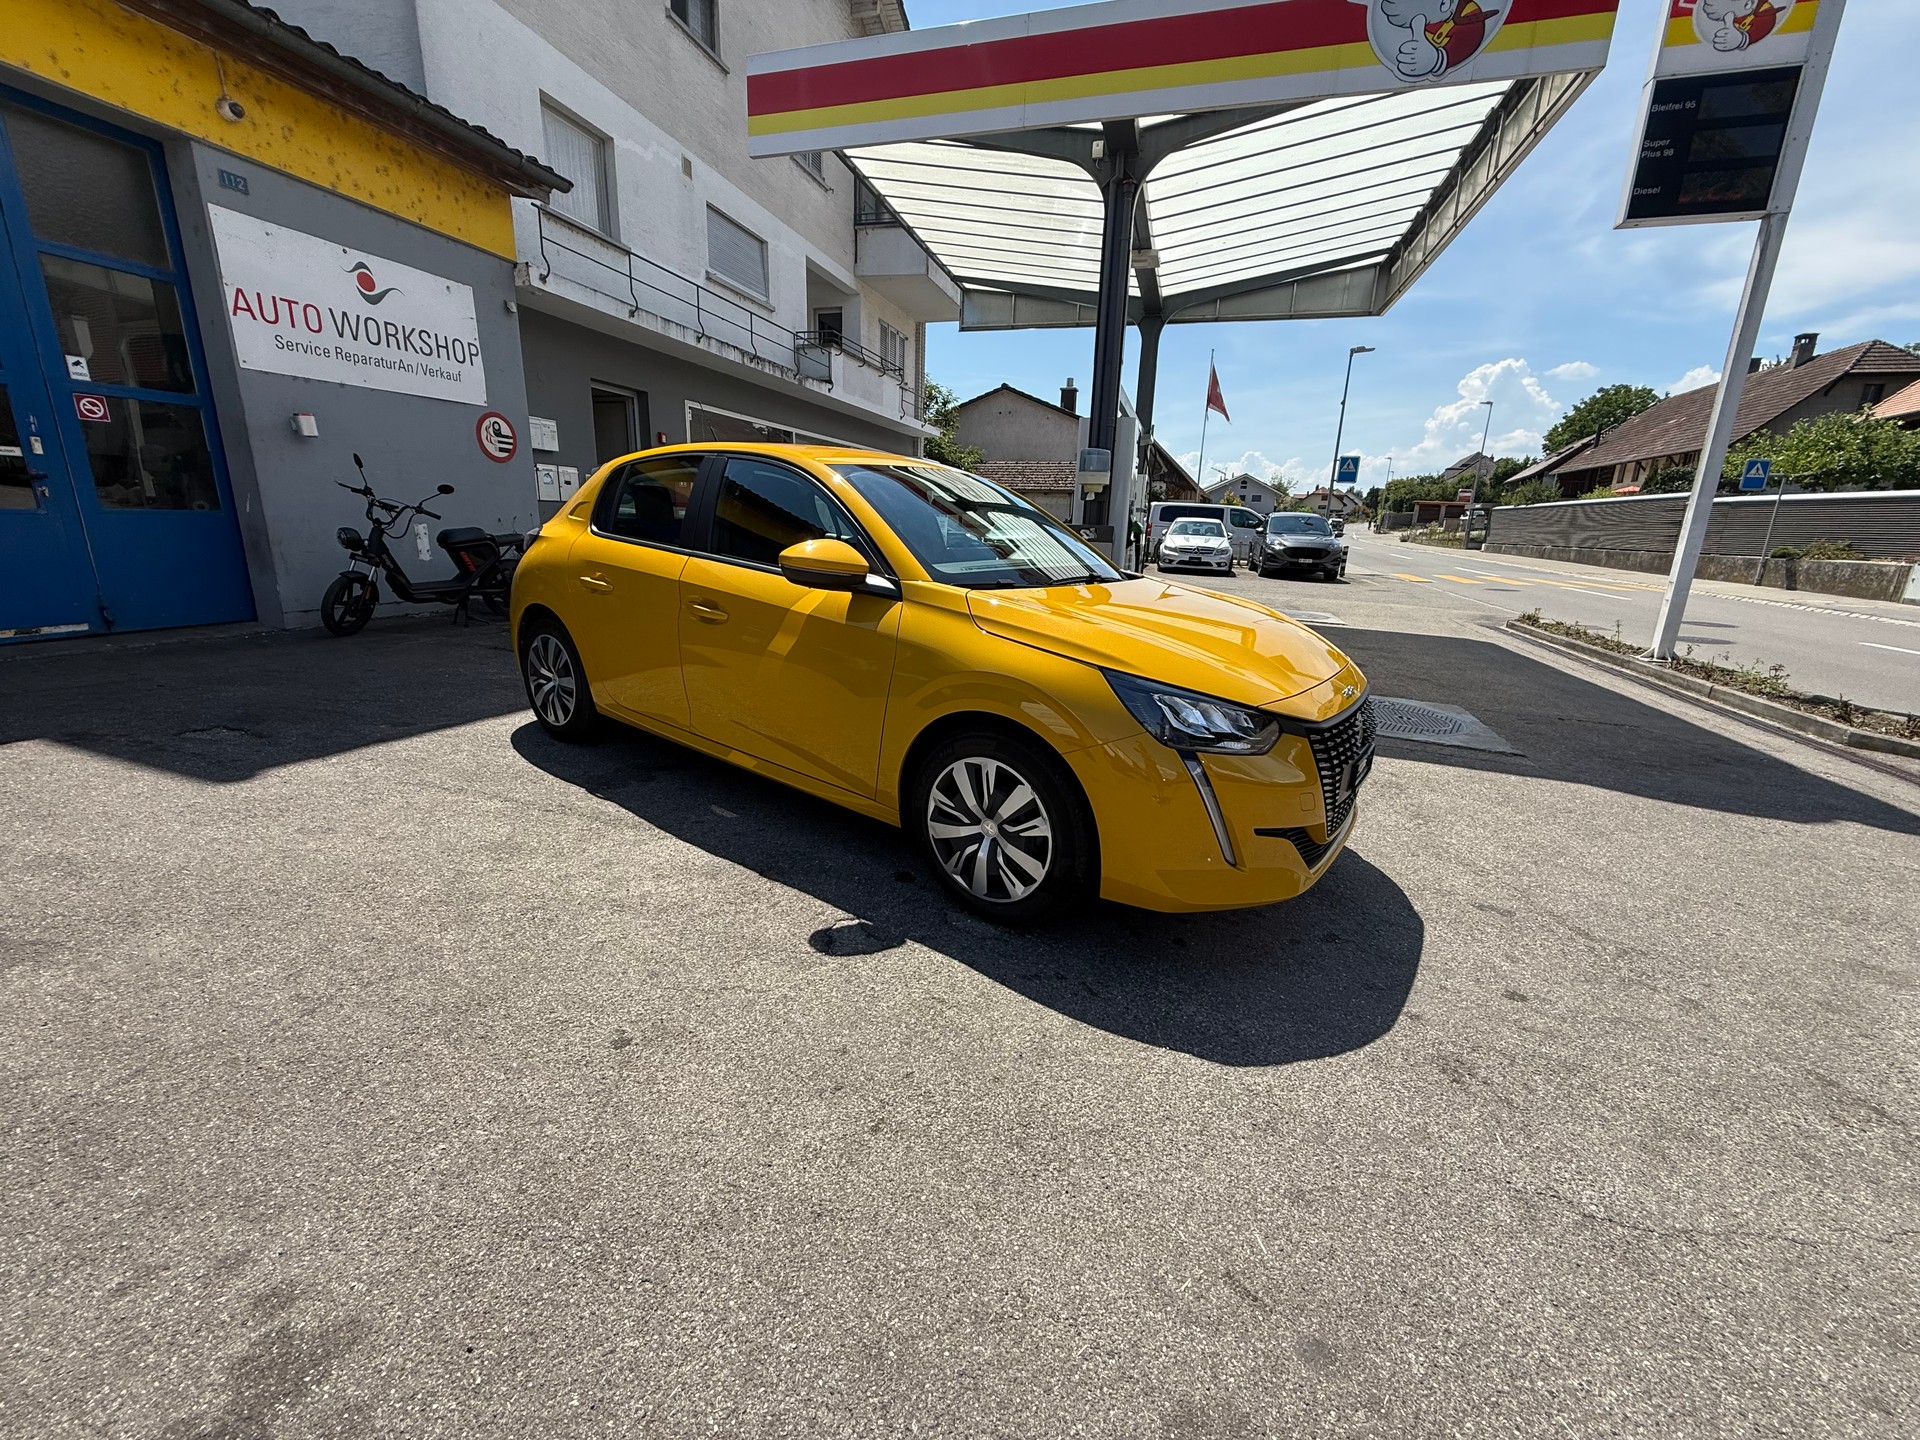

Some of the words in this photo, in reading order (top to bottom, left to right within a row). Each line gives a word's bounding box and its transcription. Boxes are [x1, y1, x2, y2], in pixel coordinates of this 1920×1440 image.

[1651, 102, 1683, 112] Bleifrei
[1685, 100, 1696, 110] 95
[1643, 139, 1670, 148] Super
[1641, 150, 1662, 159] Plus
[223, 172, 246, 190] 112
[1633, 186, 1661, 195] Diesel
[231, 287, 323, 334] AUTO
[328, 307, 480, 366] WORKSHOP
[275, 334, 331, 358] Service
